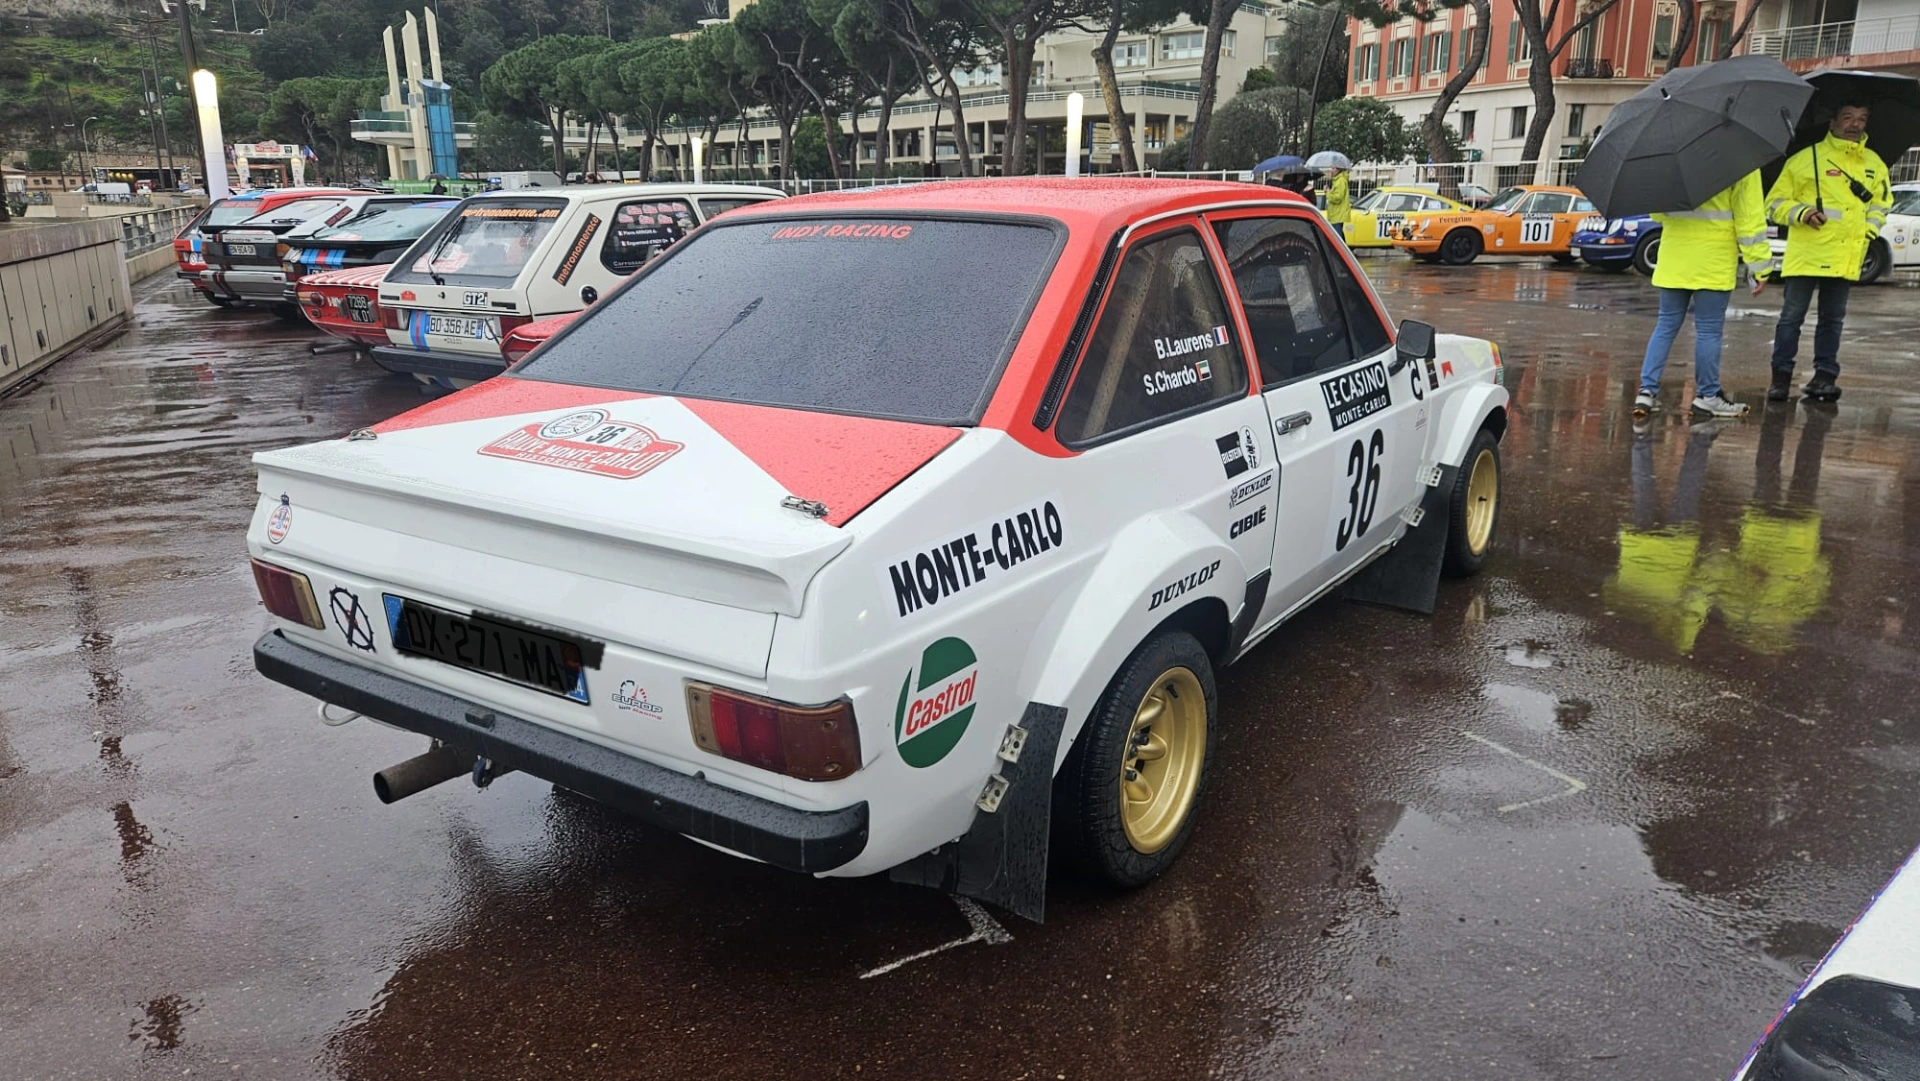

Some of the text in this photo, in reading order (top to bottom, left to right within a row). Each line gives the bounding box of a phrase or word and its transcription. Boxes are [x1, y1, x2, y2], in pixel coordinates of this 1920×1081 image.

[771, 224, 913, 240] INDY RACING
[1525, 222, 1550, 242] 101
[557, 216, 599, 285] metronomerace
[463, 291, 488, 306] GT2i
[1154, 333, 1213, 359] B.Laurens
[1143, 365, 1197, 396] S.Chardo
[1322, 365, 1386, 409] LE CASINO
[585, 426, 627, 444] 36
[515, 452, 595, 469] HISTORIQUE
[1238, 474, 1272, 499] DUNLOP
[1335, 429, 1385, 551] 36
[888, 500, 1063, 617] MONTE-CARLO
[1148, 560, 1220, 612] DUNLOP
[611, 693, 663, 713] EUROP
[905, 670, 977, 737] Castrol
